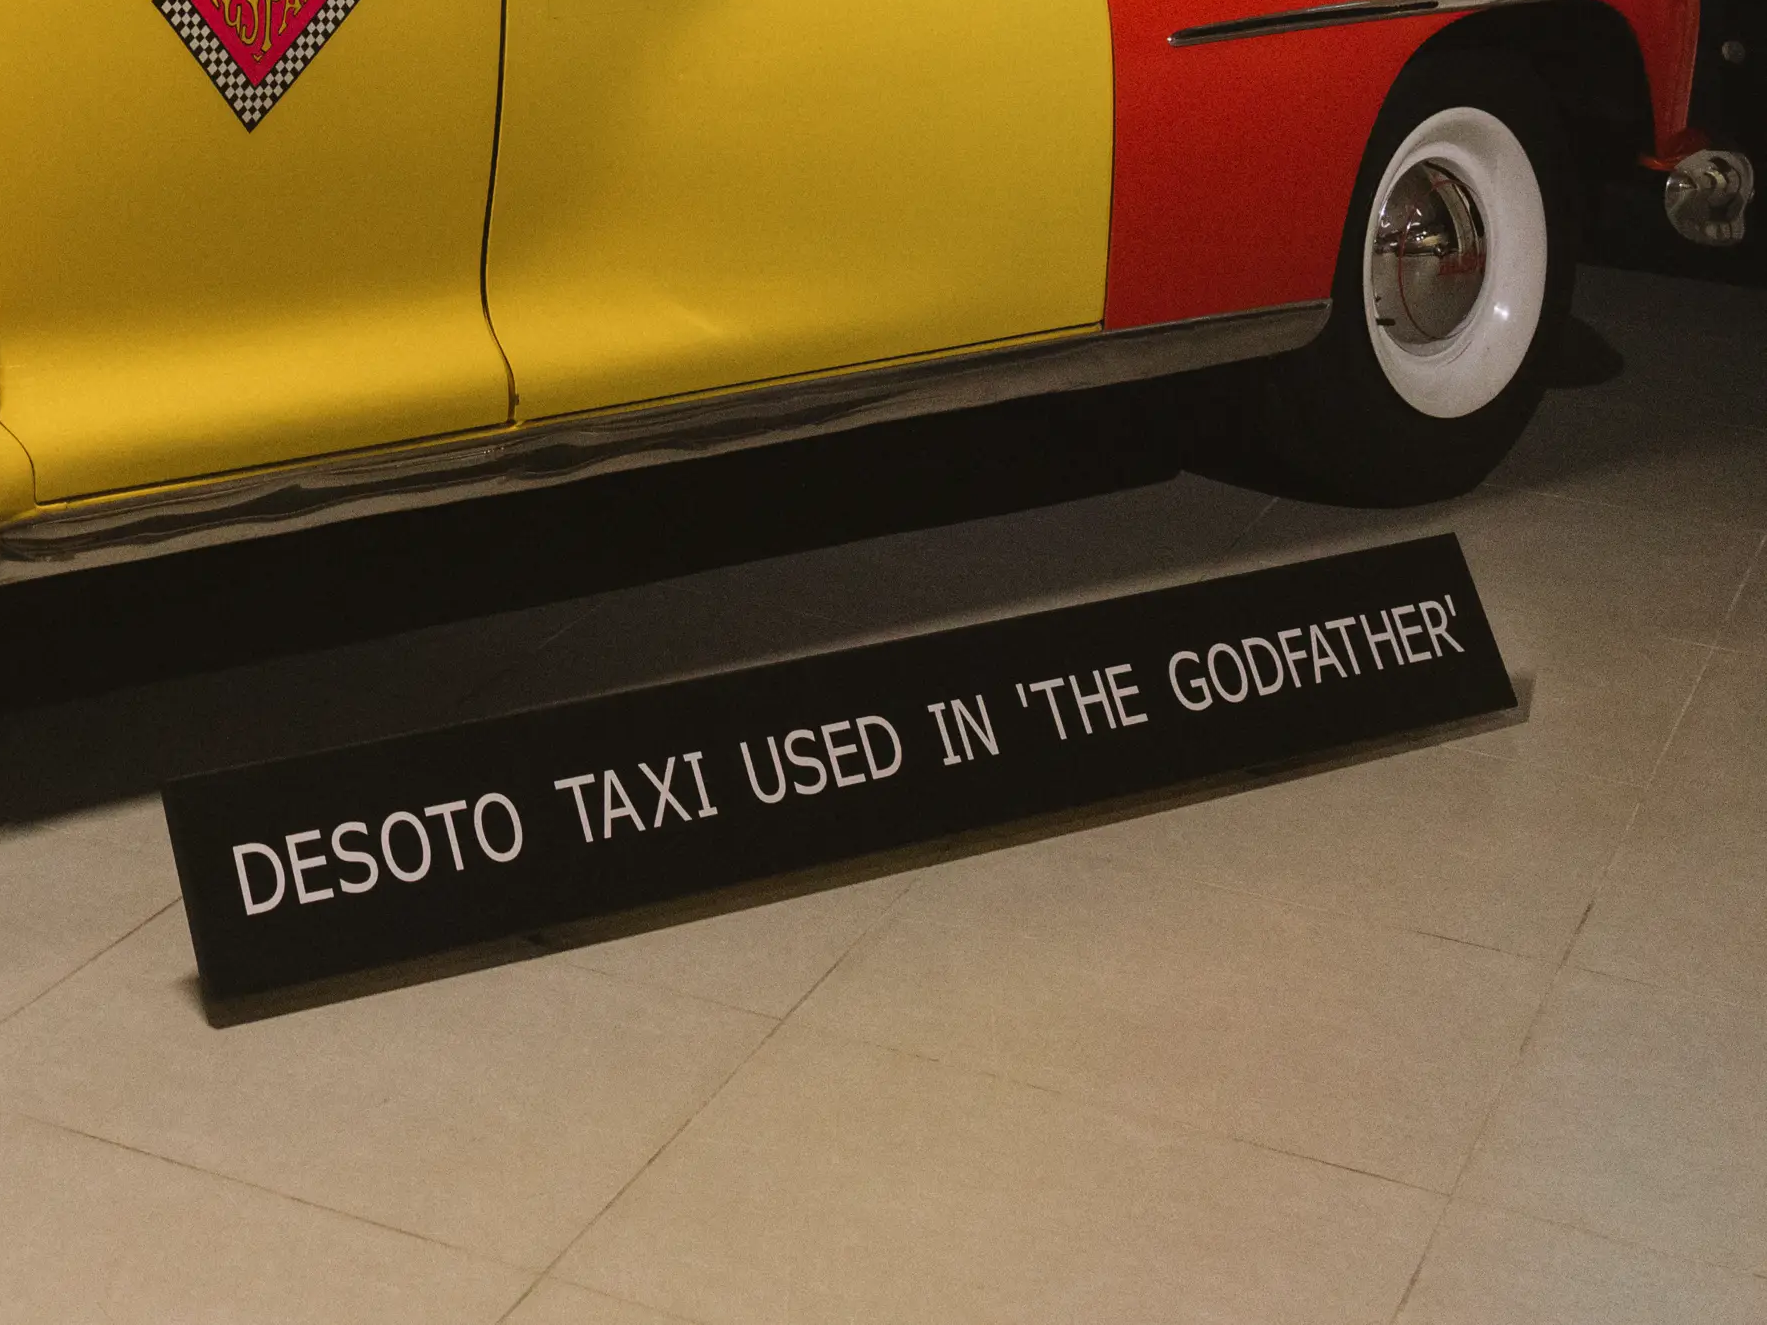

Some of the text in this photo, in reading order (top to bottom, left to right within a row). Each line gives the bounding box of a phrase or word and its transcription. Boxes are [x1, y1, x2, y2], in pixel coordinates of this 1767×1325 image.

[233, 594, 1465, 916] DESOTO TAXI USED IN 'THE GODFATHER'
